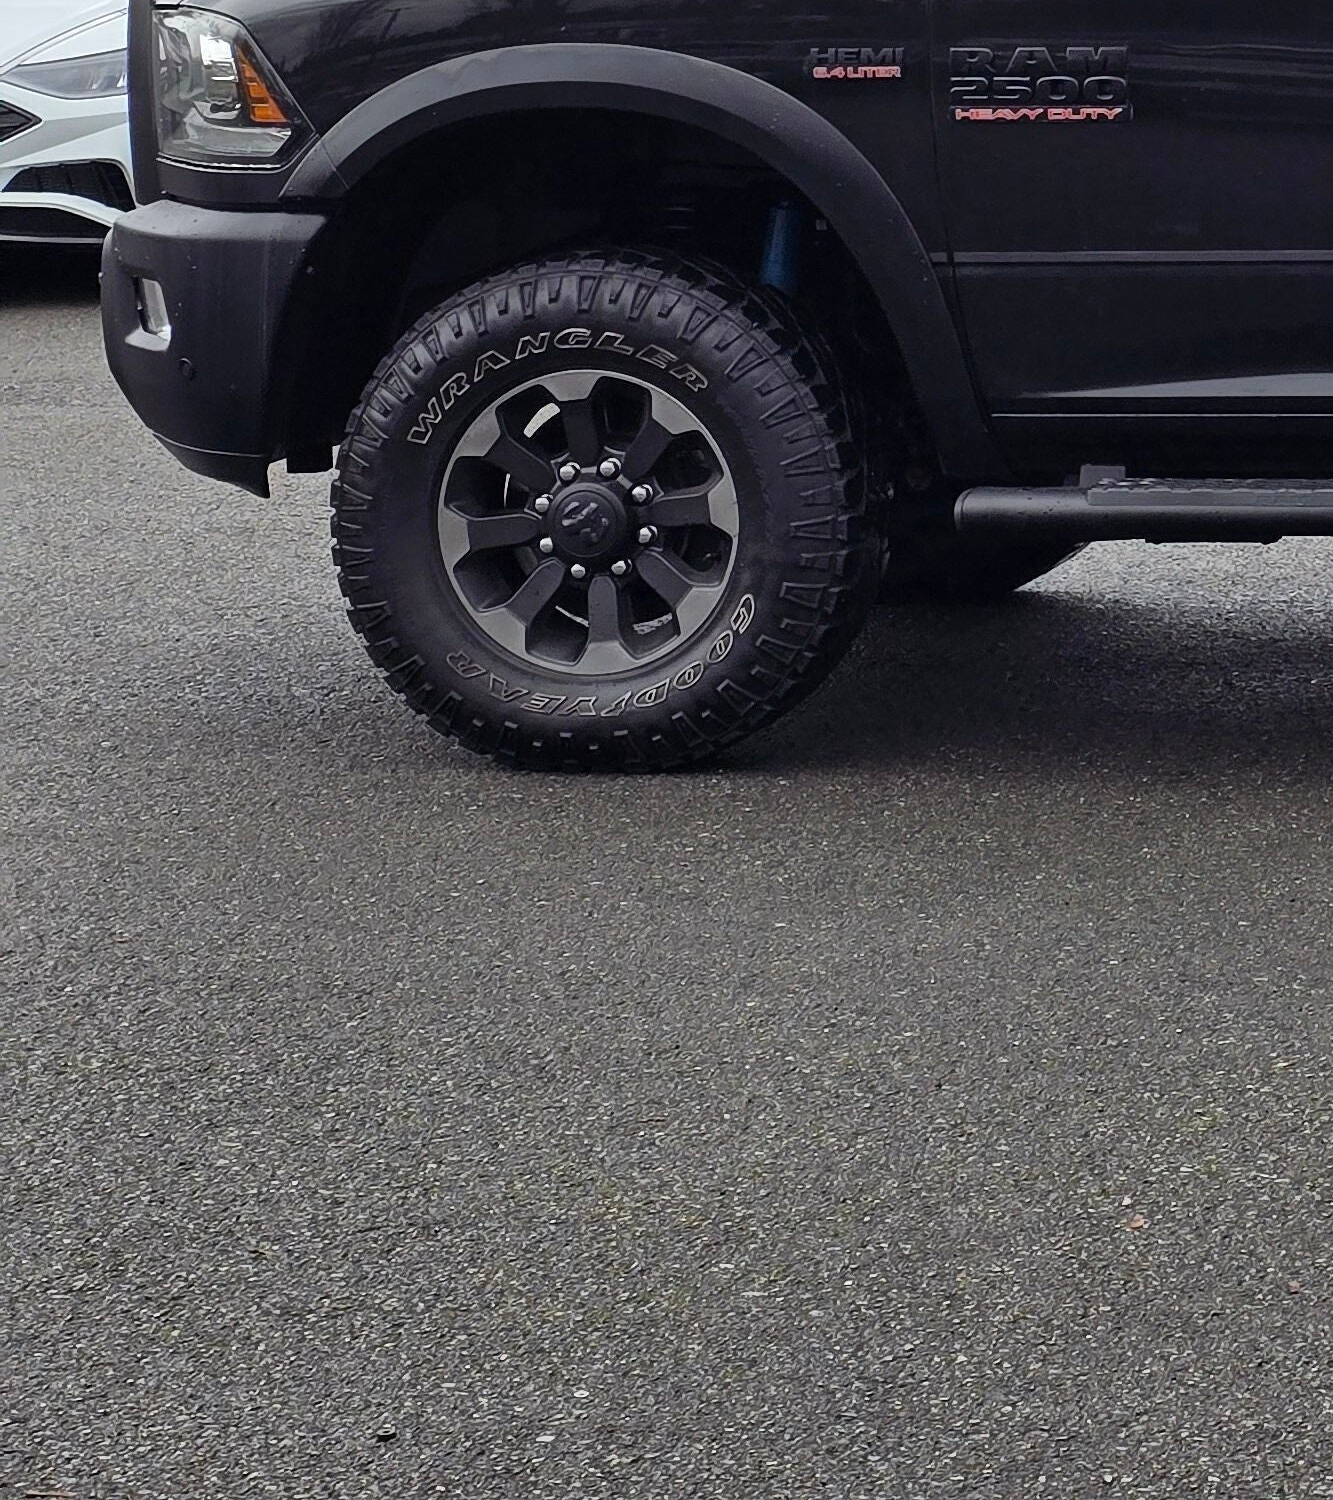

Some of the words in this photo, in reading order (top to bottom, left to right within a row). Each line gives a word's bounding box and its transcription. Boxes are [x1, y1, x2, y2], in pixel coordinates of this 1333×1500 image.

[810, 47, 905, 64] HEMI
[950, 46, 1128, 73] RAM
[812, 66, 846, 79] 6.4
[846, 66, 902, 78] LITER
[950, 75, 1127, 100] 2500
[955, 107, 1044, 121] HEAVY
[1048, 107, 1123, 121] DUTY
[406, 327, 709, 445] WRANGLER
[446, 593, 756, 717] GOODYEAR
